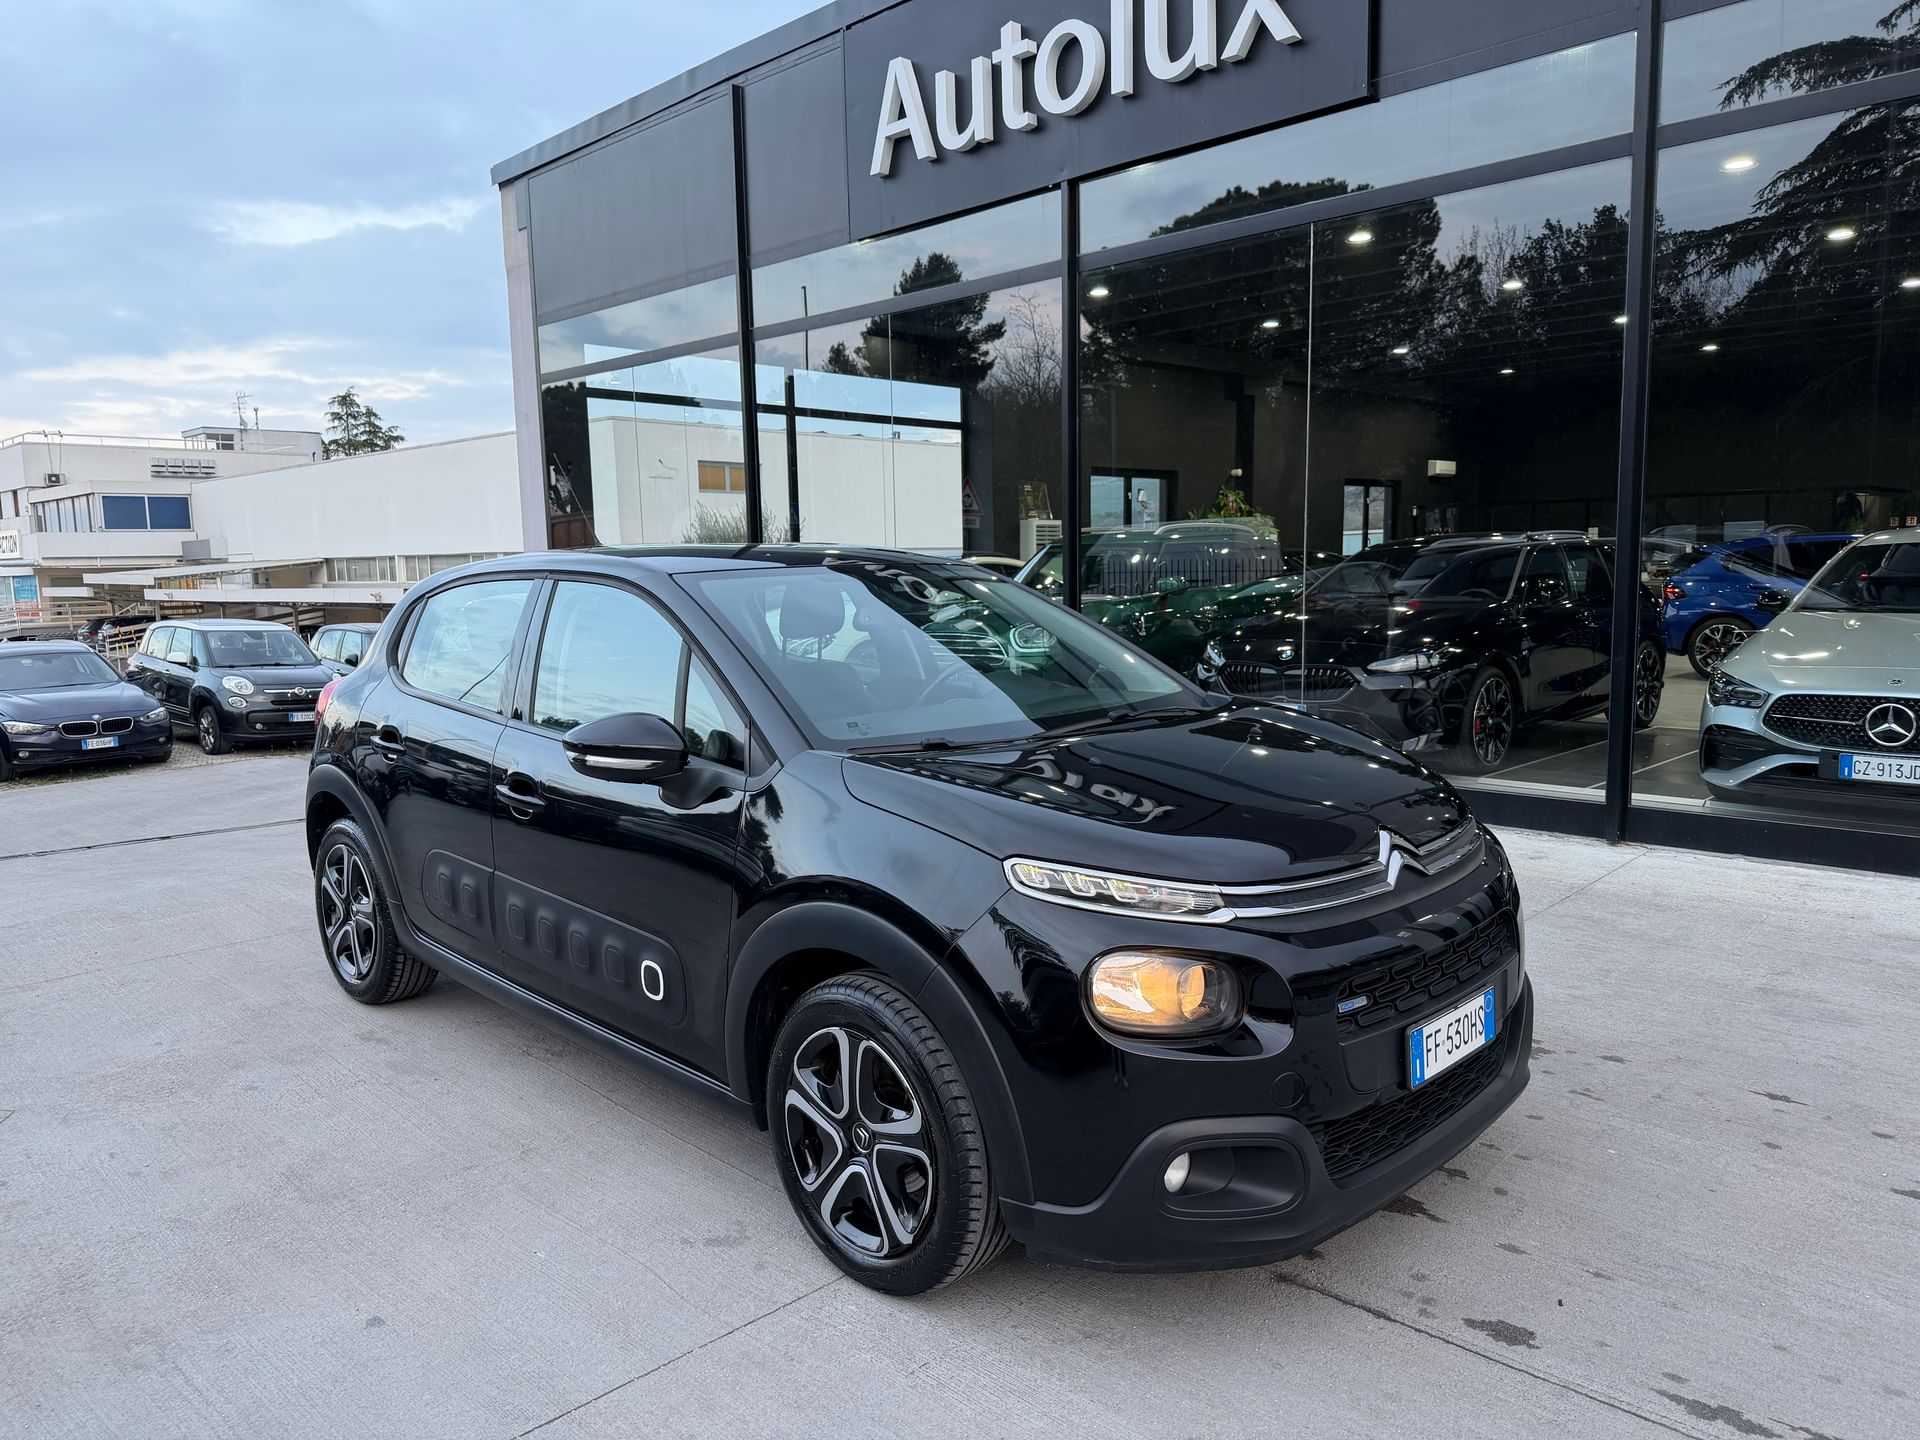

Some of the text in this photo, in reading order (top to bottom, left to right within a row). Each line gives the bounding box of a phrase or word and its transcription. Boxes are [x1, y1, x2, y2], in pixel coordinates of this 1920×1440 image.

[0, 535, 17, 553] CTION
[1854, 760, 1871, 776] GZ
[1425, 1028, 1442, 1068] FF
[1446, 1005, 1485, 1055] 530HS
